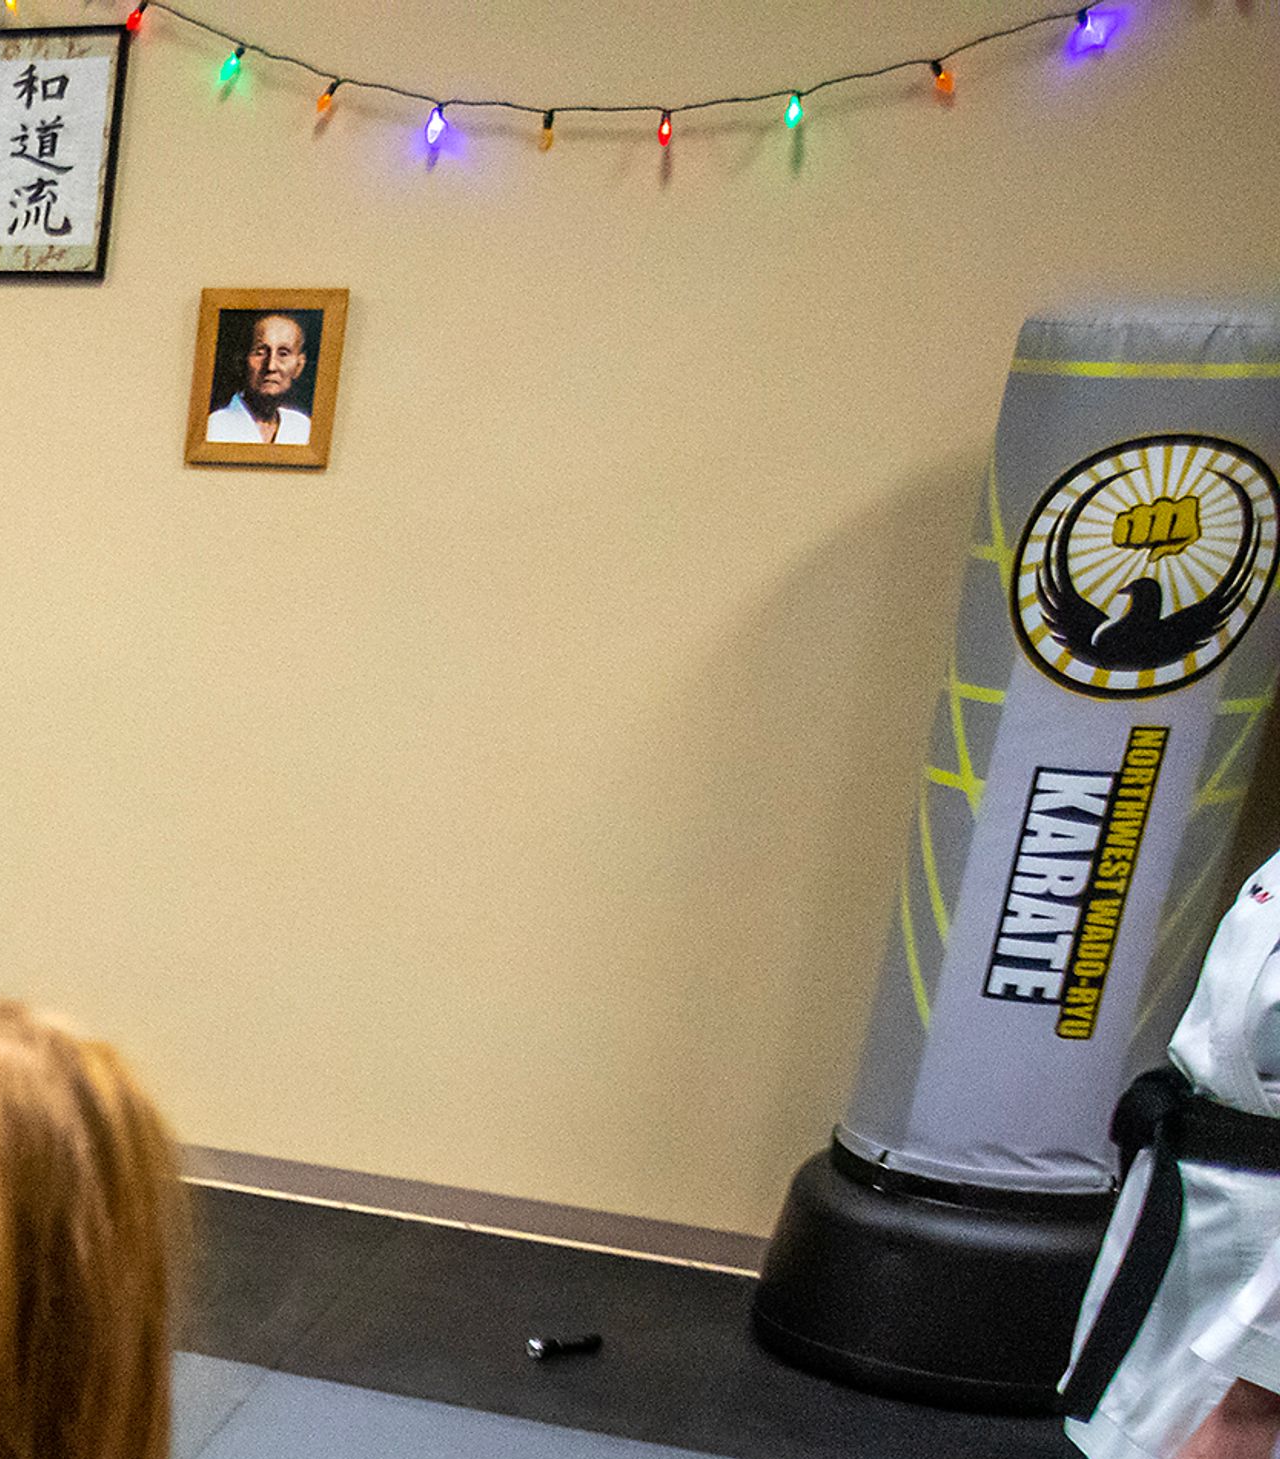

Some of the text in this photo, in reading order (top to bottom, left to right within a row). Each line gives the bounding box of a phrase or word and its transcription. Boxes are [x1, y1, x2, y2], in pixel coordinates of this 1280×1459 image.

[7, 63, 74, 237] 和道流
[986, 770, 1114, 1002] KARATE
[1058, 729, 1167, 1040] NORTHWEST WADO-RYU
